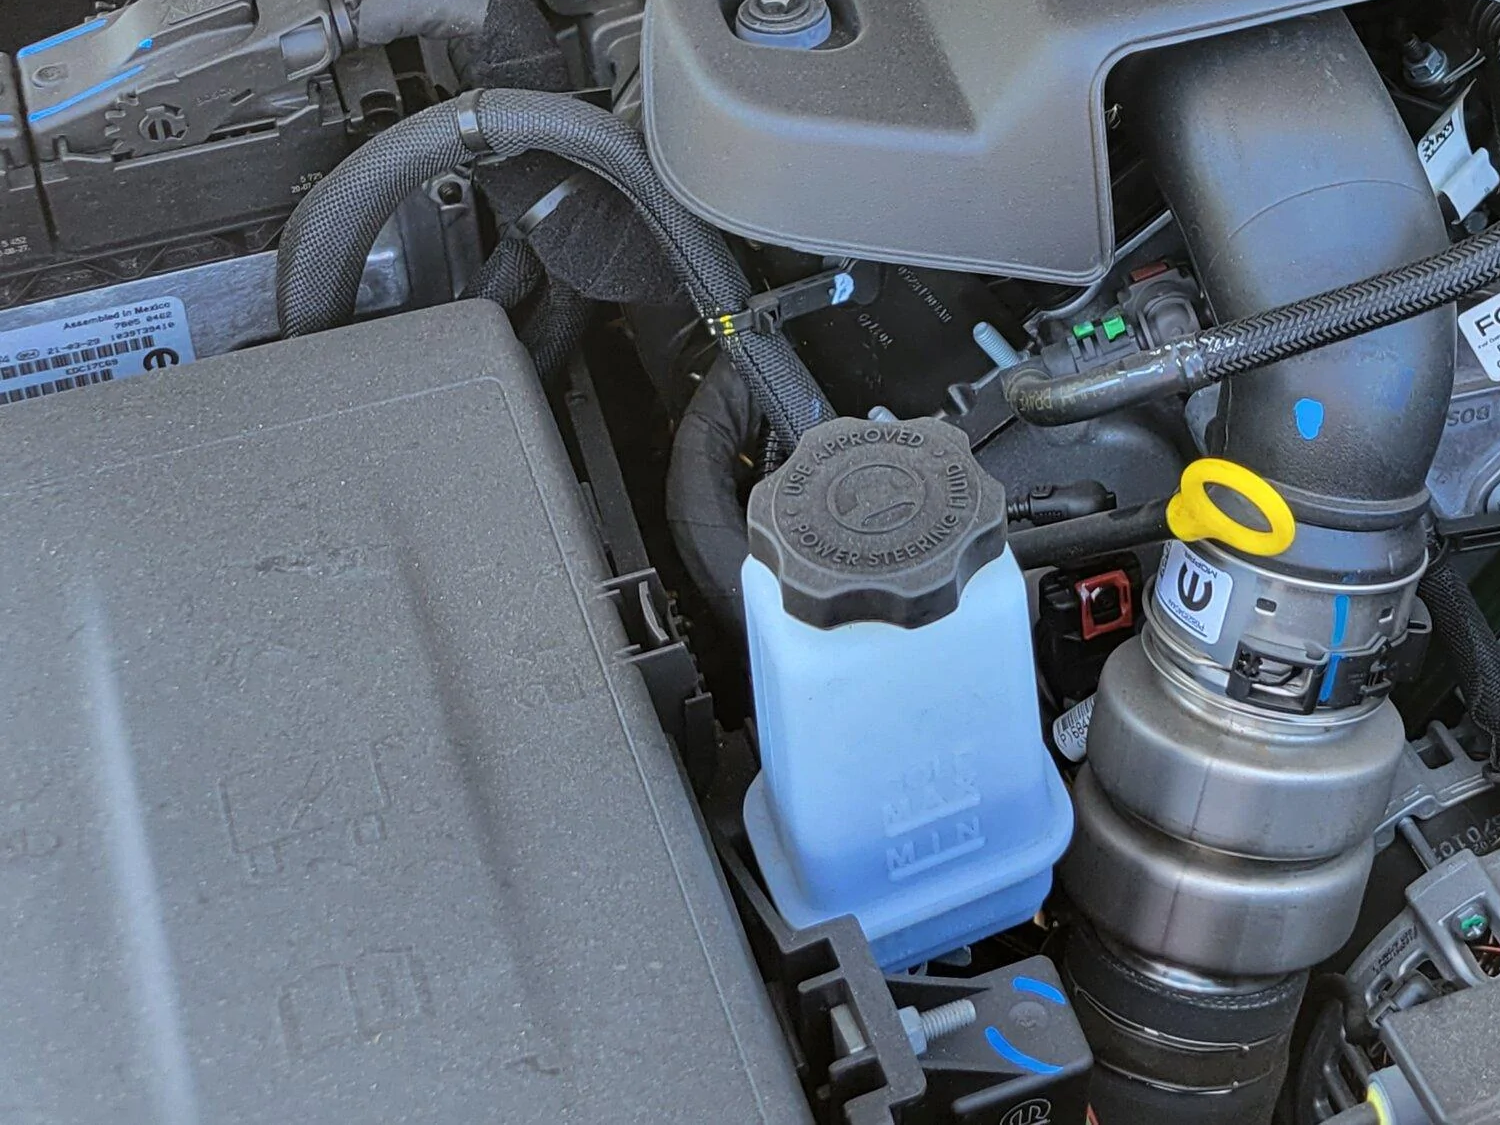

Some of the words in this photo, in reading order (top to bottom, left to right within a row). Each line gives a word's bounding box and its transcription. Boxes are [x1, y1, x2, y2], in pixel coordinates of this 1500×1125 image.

[63, 312, 120, 331] Assembled
[134, 301, 171, 315] Mexico
[1446, 404, 1491, 427] BOS
[782, 463, 813, 496] USE
[813, 427, 925, 465] APPROVED
[790, 523, 860, 566] POWER
[867, 513, 960, 567] STEERING
[945, 461, 970, 510] FLUID
[886, 815, 980, 867] MIN
